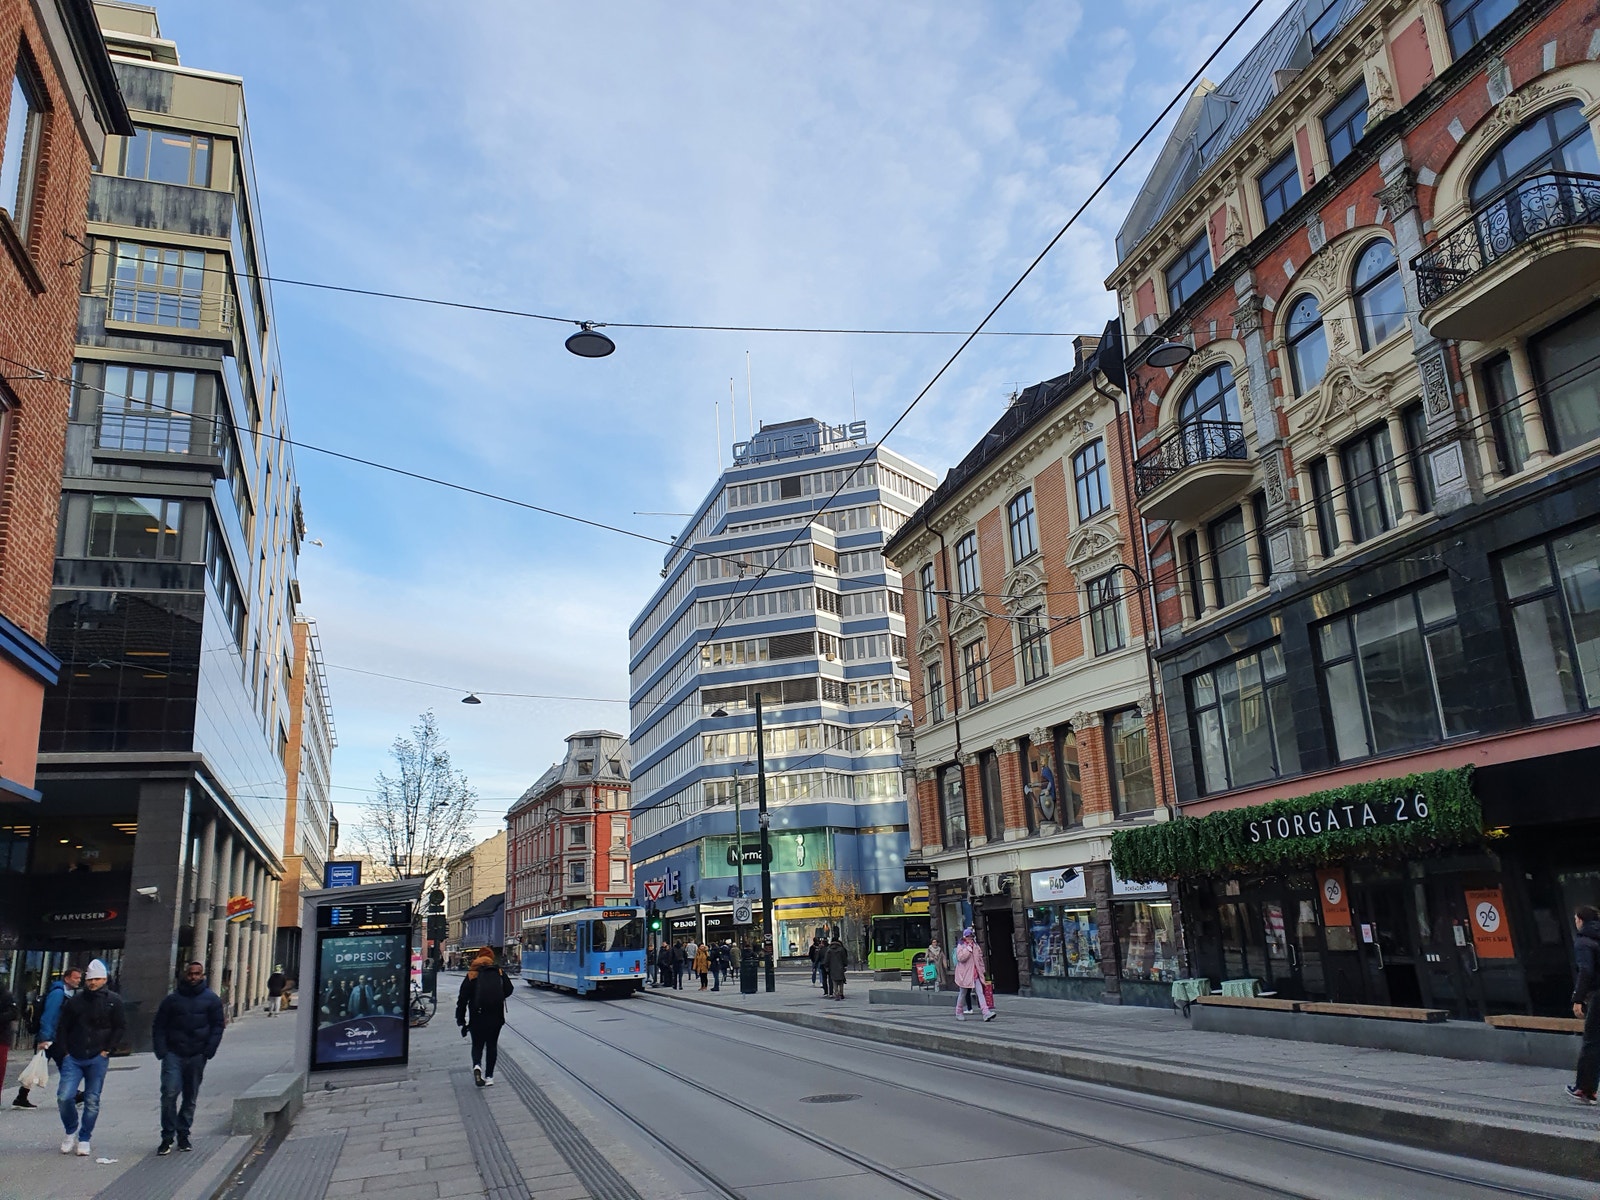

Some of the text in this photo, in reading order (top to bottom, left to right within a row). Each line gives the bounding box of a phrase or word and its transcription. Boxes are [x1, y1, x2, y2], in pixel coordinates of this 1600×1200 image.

[1250, 794, 1429, 843] STORGATA 26
[1326, 881, 1339, 900] 26
[54, 912, 105, 921] NARVESEN
[737, 910, 748, 918] 30
[1480, 905, 1496, 927] 26
[335, 951, 392, 963] DOPESICK
